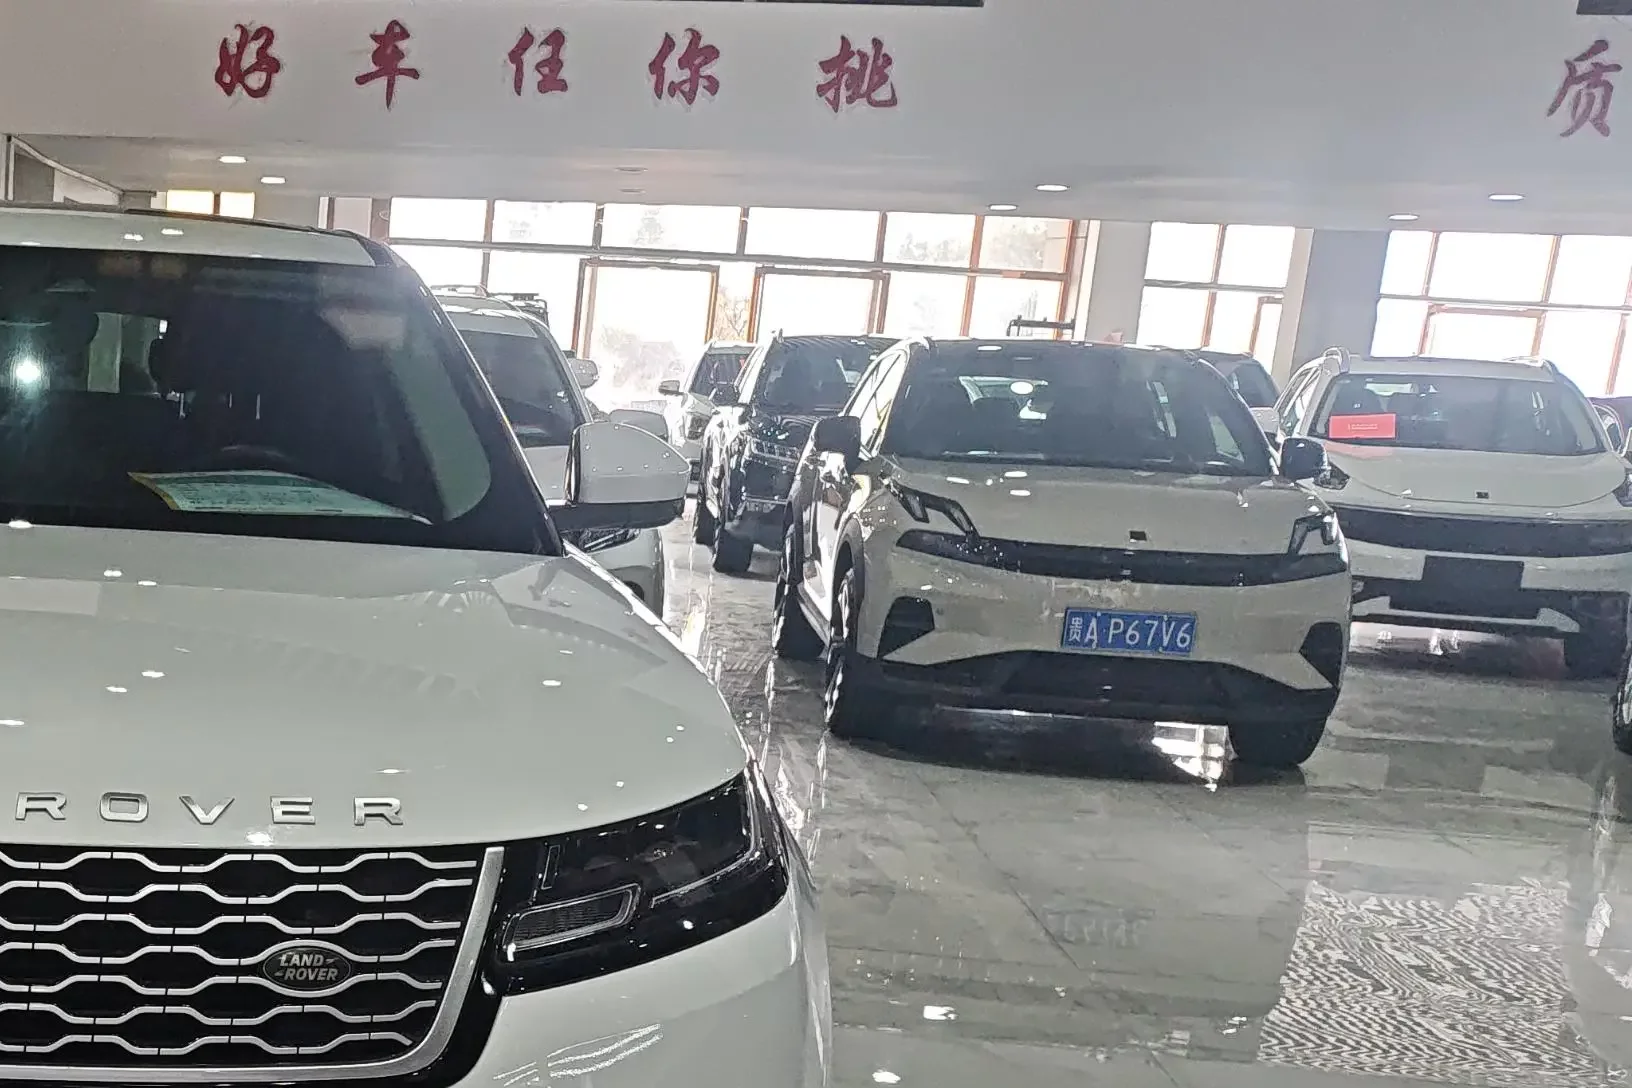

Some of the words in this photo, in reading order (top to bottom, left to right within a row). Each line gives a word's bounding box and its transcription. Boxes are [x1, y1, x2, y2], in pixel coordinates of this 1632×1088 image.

[214, 20, 898, 112] 好车任你挑
[1547, 39, 1623, 137] 质
[15, 791, 405, 826] ROVER
[279, 952, 325, 967] LAND
[283, 967, 339, 981] ROVER
